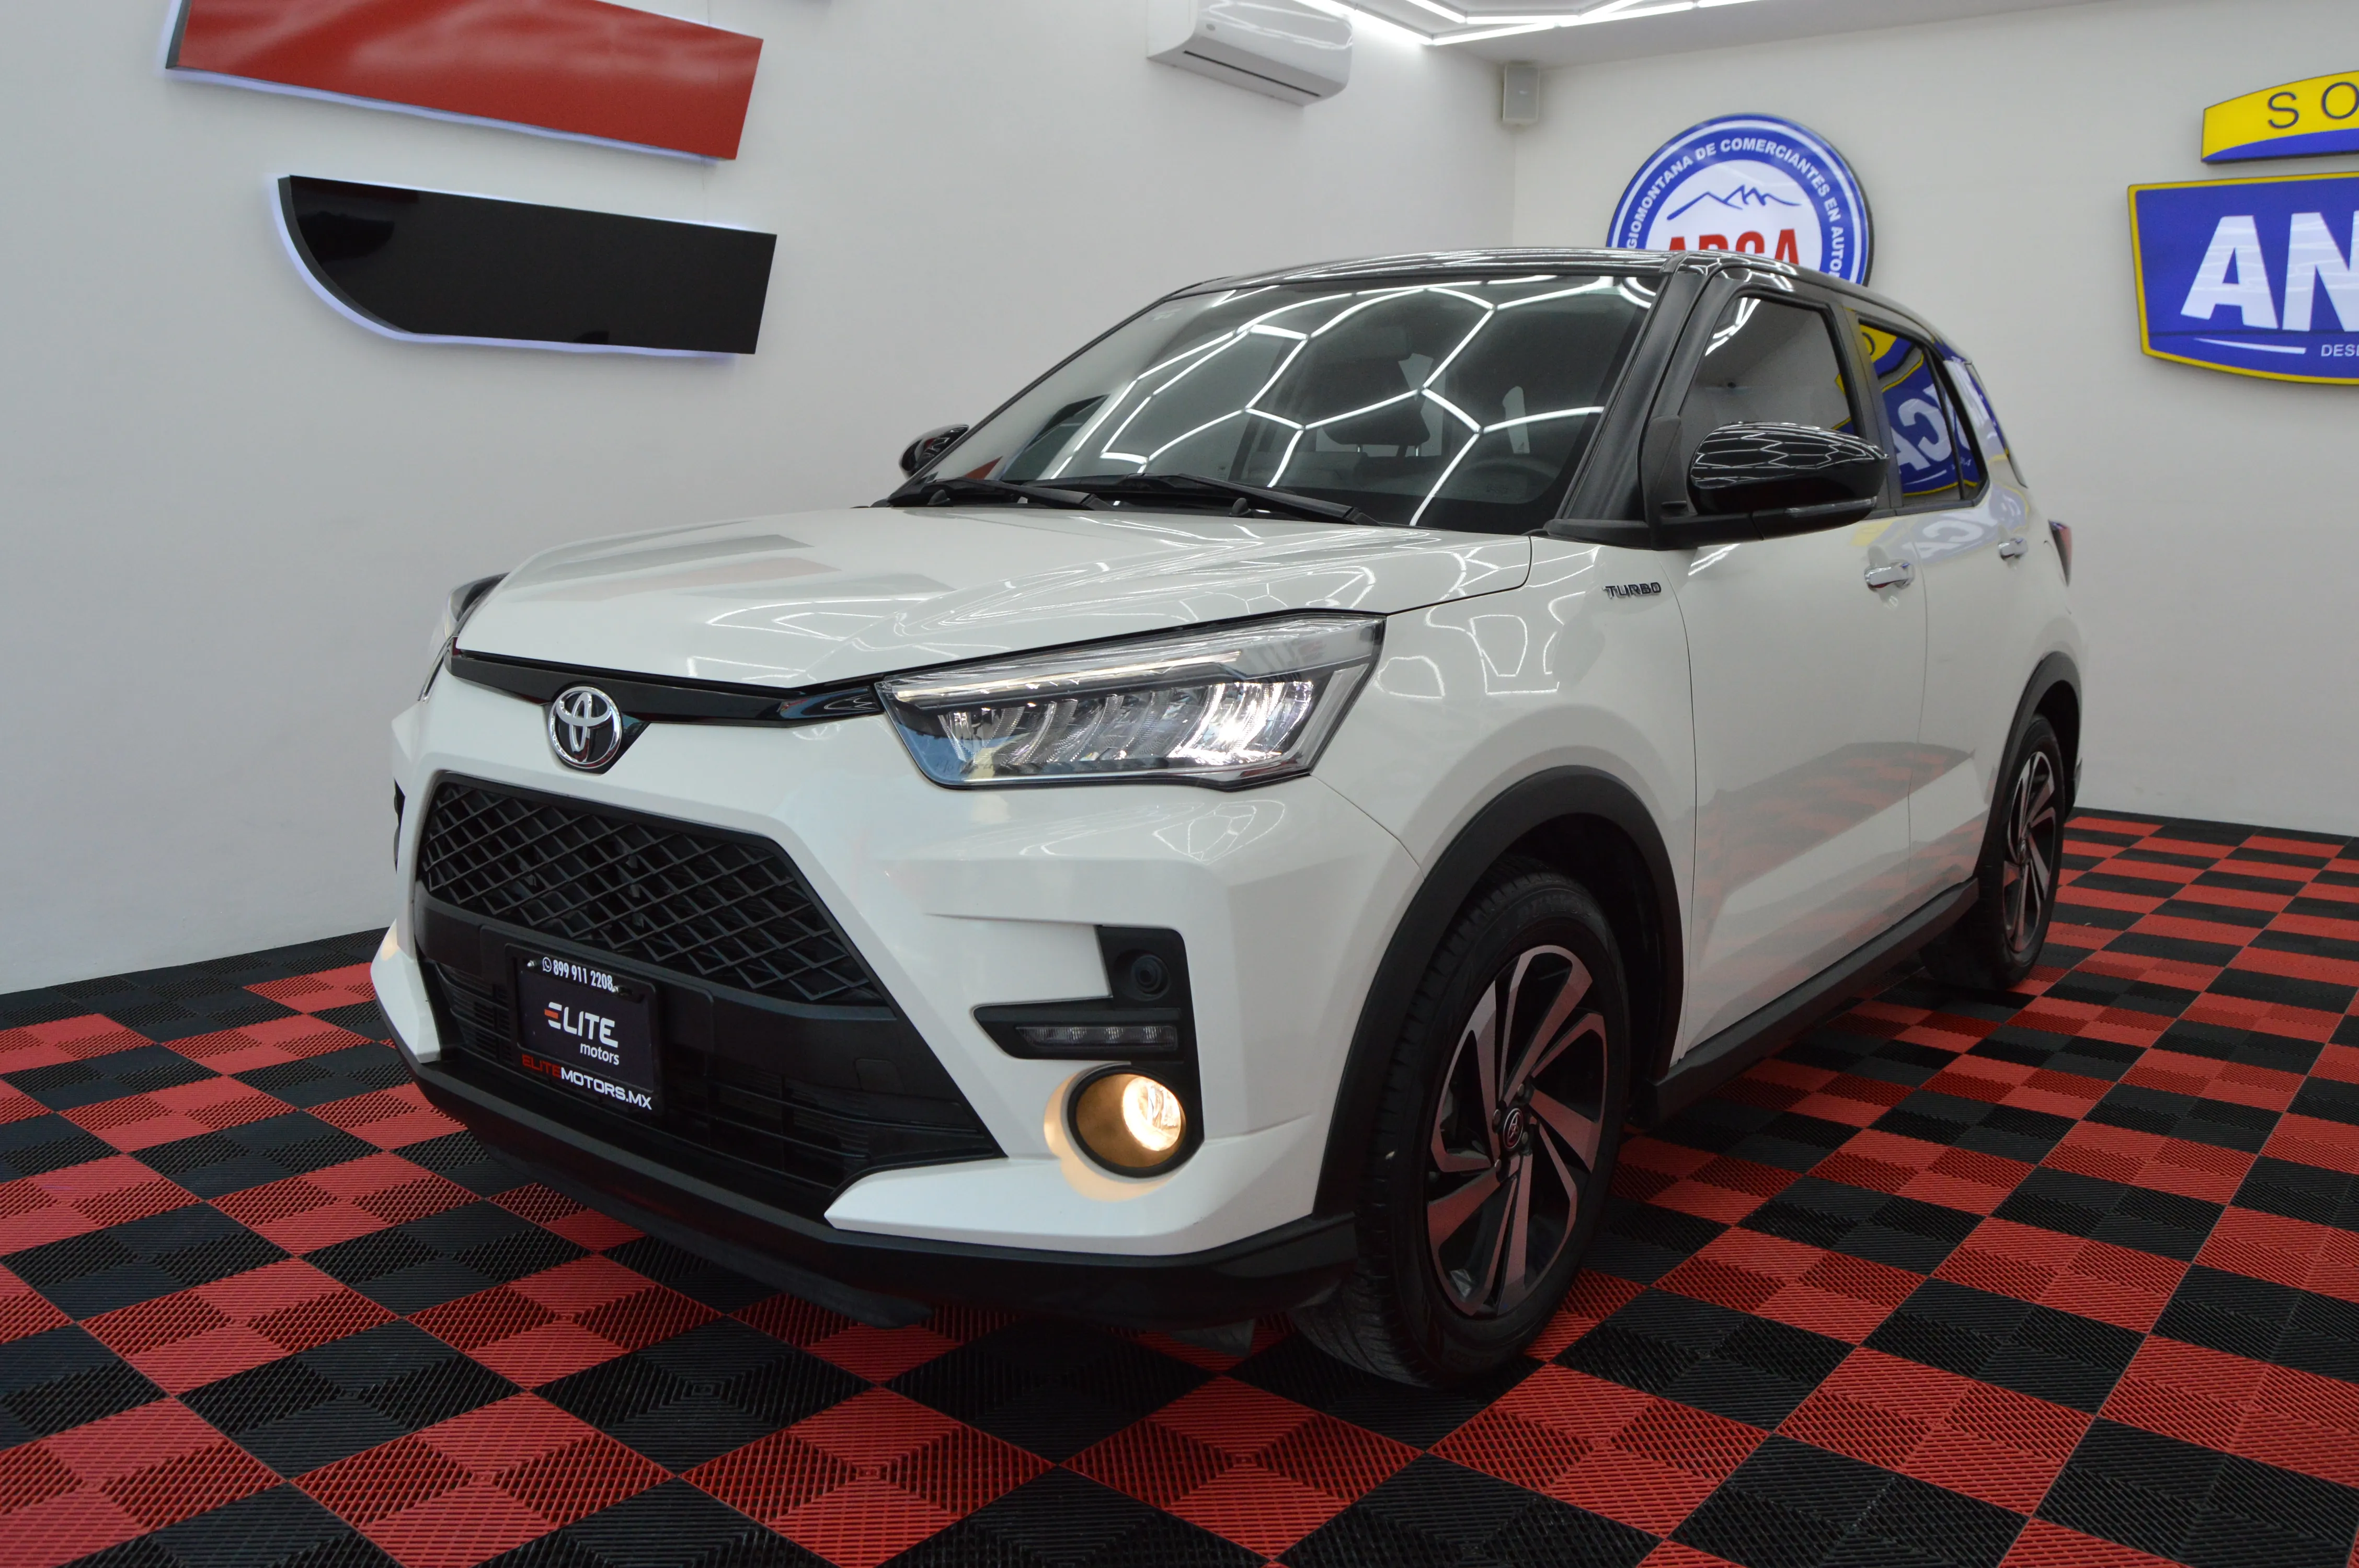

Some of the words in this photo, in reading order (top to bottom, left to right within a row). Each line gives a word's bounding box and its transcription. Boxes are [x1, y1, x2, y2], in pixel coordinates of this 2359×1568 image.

[1695, 142, 1716, 160] DE
[1720, 137, 1830, 198] COMERCIANTES
[1824, 197, 1841, 222] EN
[1602, 582, 1662, 599] TURBO
[553, 960, 569, 978] 899
[571, 965, 587, 984] 911
[544, 1001, 618, 1048] ELITE
[580, 1043, 620, 1065] motors
[522, 1054, 652, 1110] ELITEMOTORS.MX
